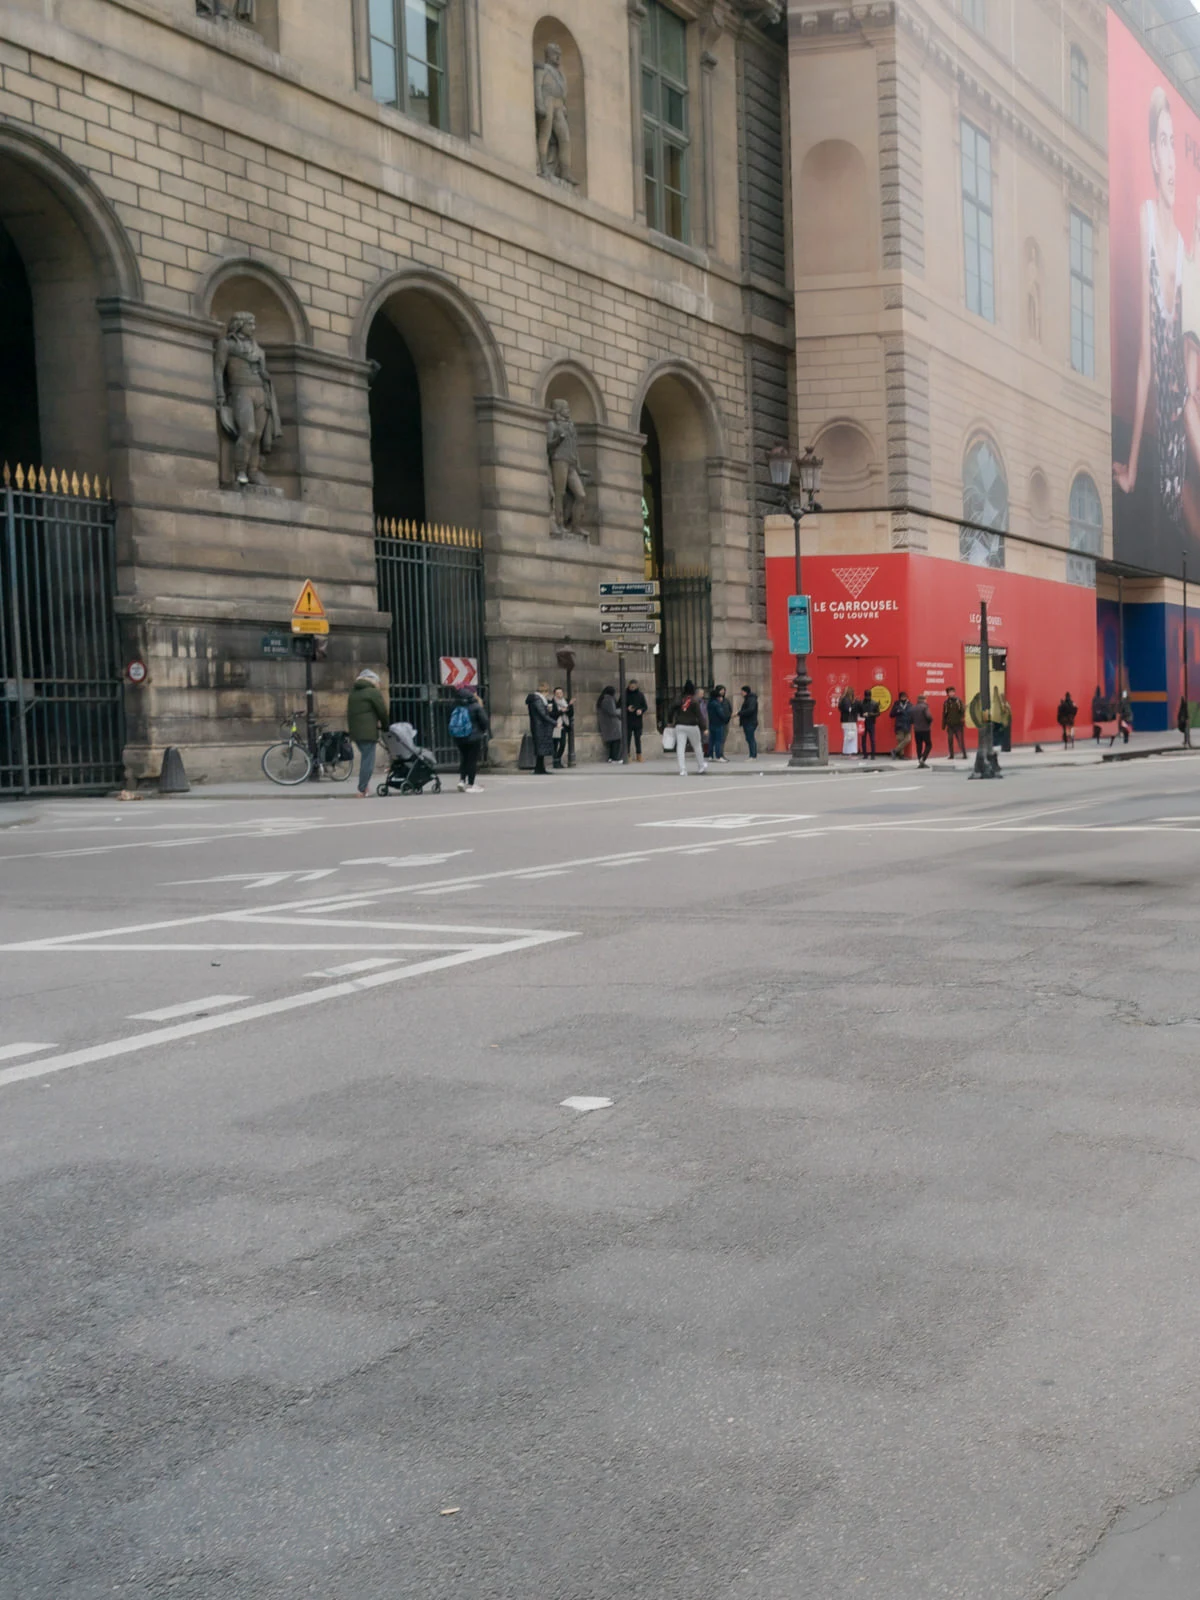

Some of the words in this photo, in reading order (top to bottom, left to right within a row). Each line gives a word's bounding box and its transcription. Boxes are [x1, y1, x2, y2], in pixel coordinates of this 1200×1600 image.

[814, 602, 827, 612] LE
[829, 600, 898, 612] CARROUSEL
[833, 612, 845, 620] DU
[847, 611, 880, 619] LOUVRE
